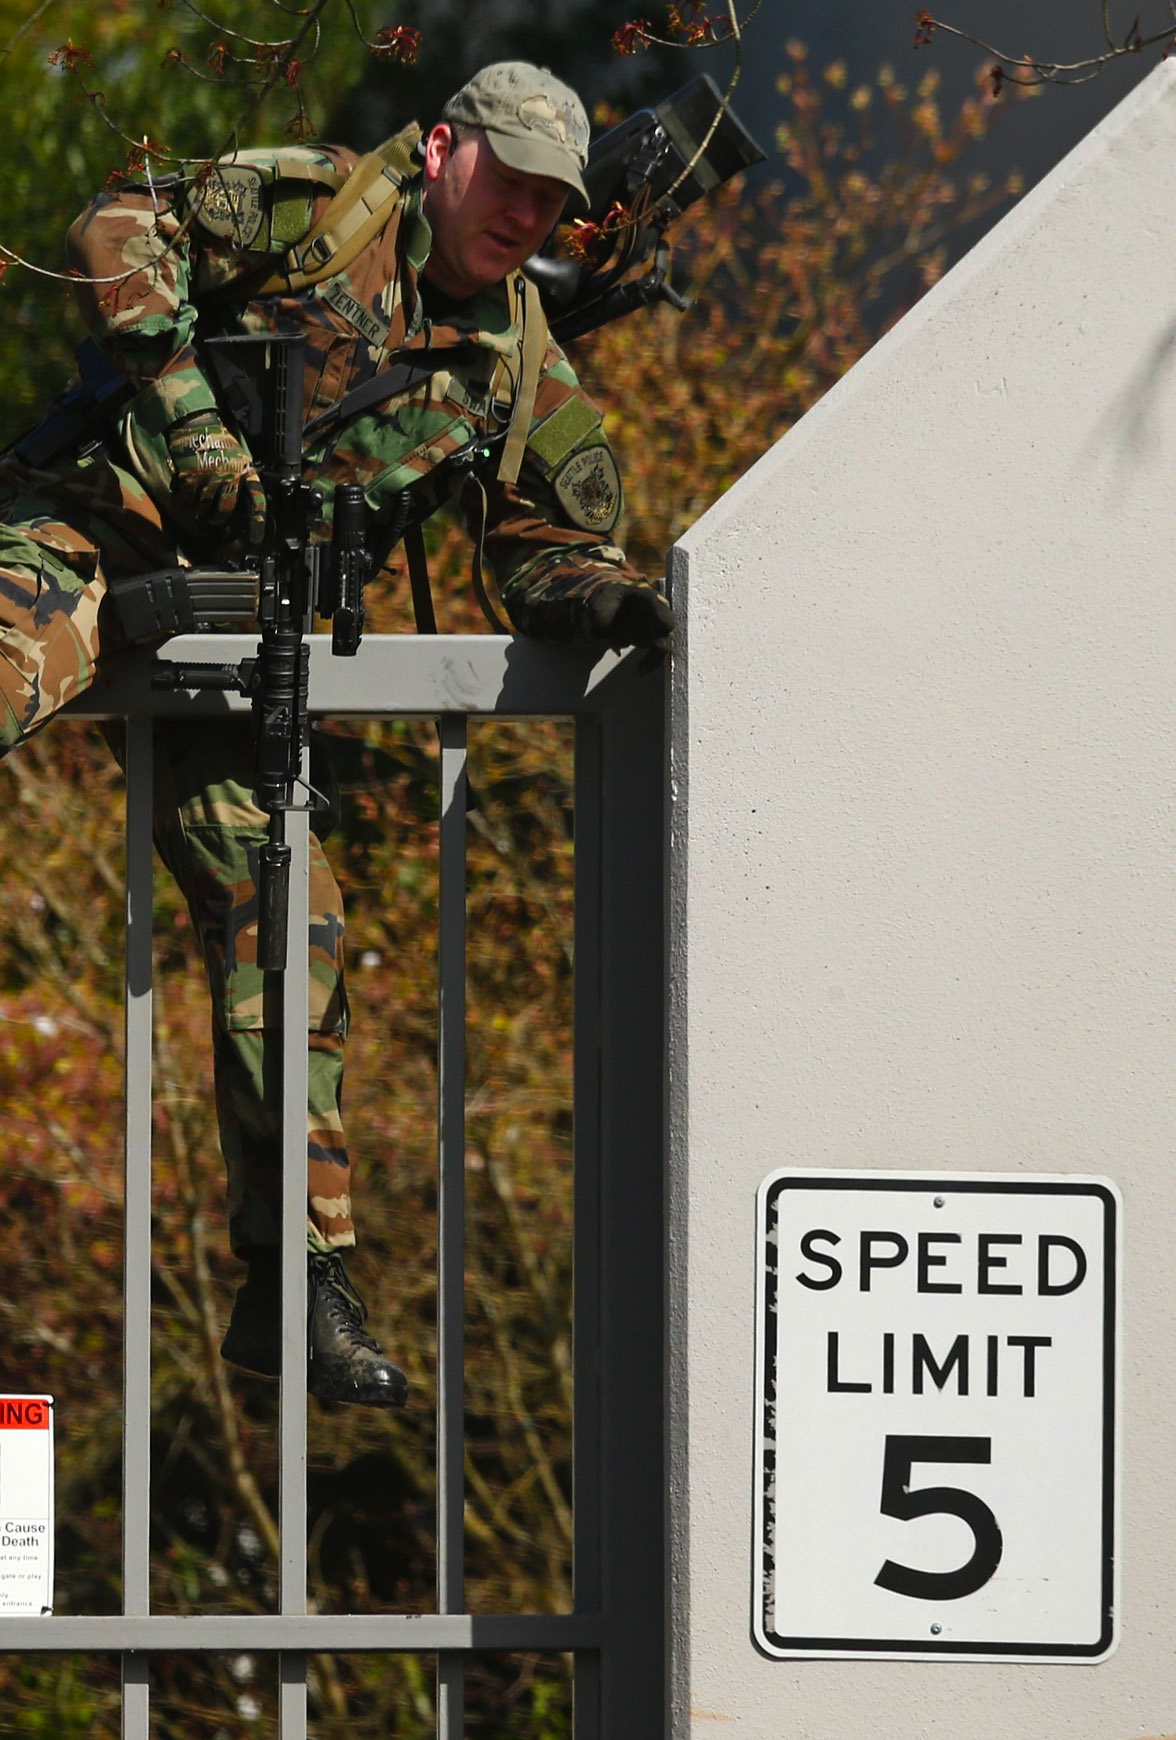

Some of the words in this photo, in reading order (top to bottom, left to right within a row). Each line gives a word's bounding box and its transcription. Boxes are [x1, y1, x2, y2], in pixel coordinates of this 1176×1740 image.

[329, 289, 380, 339] ZENTNER
[795, 1229, 1088, 1296] SPEED
[827, 1331, 1053, 1397] LIMIT
[1, 1535, 39, 1547] Death
[5, 1521, 46, 1533] Cause
[873, 1435, 1003, 1601] 5
[27, 1573, 42, 1581] play
